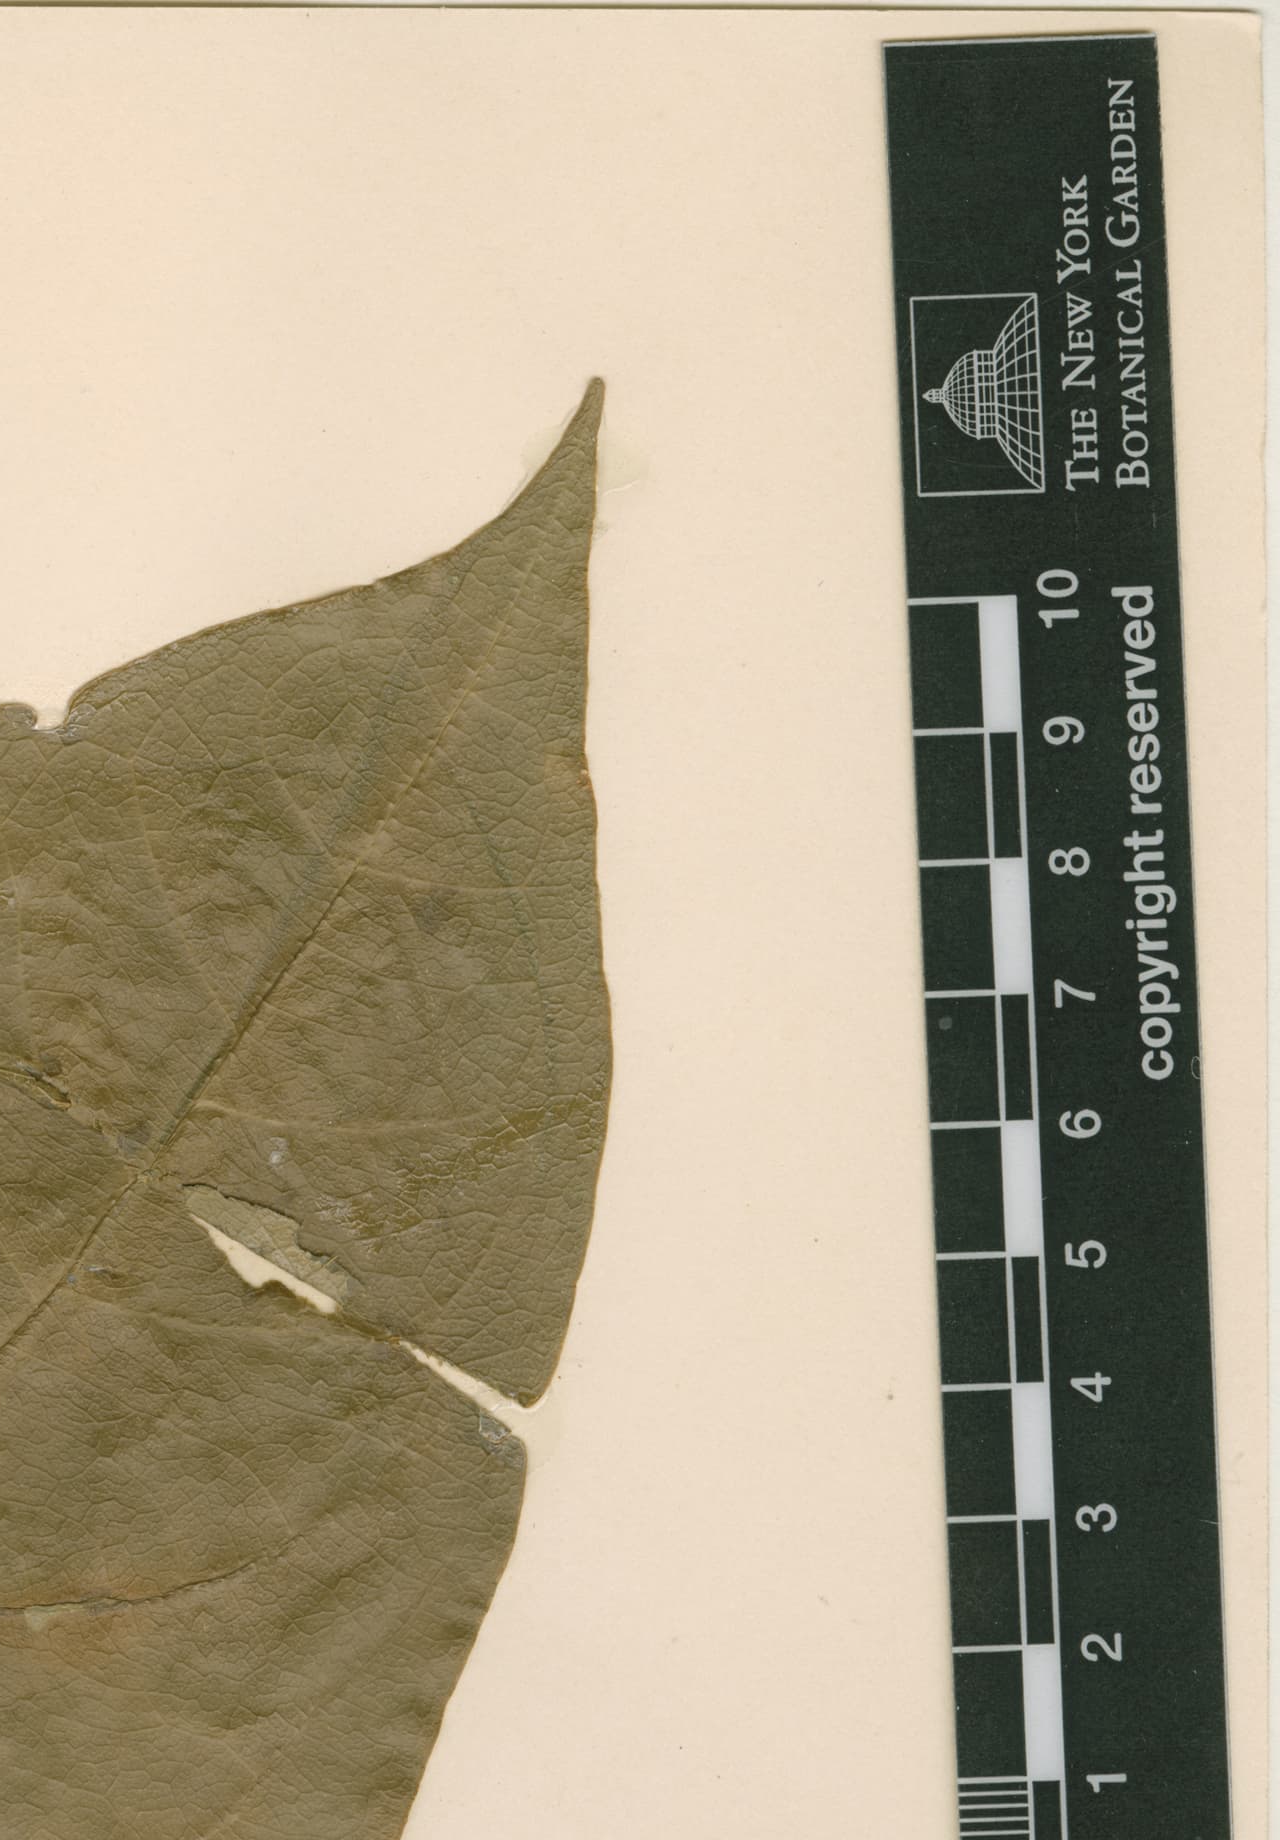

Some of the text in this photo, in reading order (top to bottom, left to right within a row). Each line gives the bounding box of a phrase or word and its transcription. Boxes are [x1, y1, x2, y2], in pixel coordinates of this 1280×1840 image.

[1105, 78, 1150, 489] BOTANICAL GARDEN
[1055, 174, 1100, 491] THE NEW YORK
[1036, 569, 1080, 629] 10
[1042, 716, 1085, 746] 9
[1111, 584, 1180, 1081] copyright reserved
[1048, 846, 1091, 877] 8
[1054, 979, 1096, 1008] 7
[1059, 1108, 1102, 1139] 6
[1064, 1239, 1107, 1269] 5
[1070, 1372, 1112, 1403] 4
[1075, 1503, 1117, 1532] 3
[1080, 1632, 1122, 1662] 2
[1086, 1773, 1127, 1793] 1
